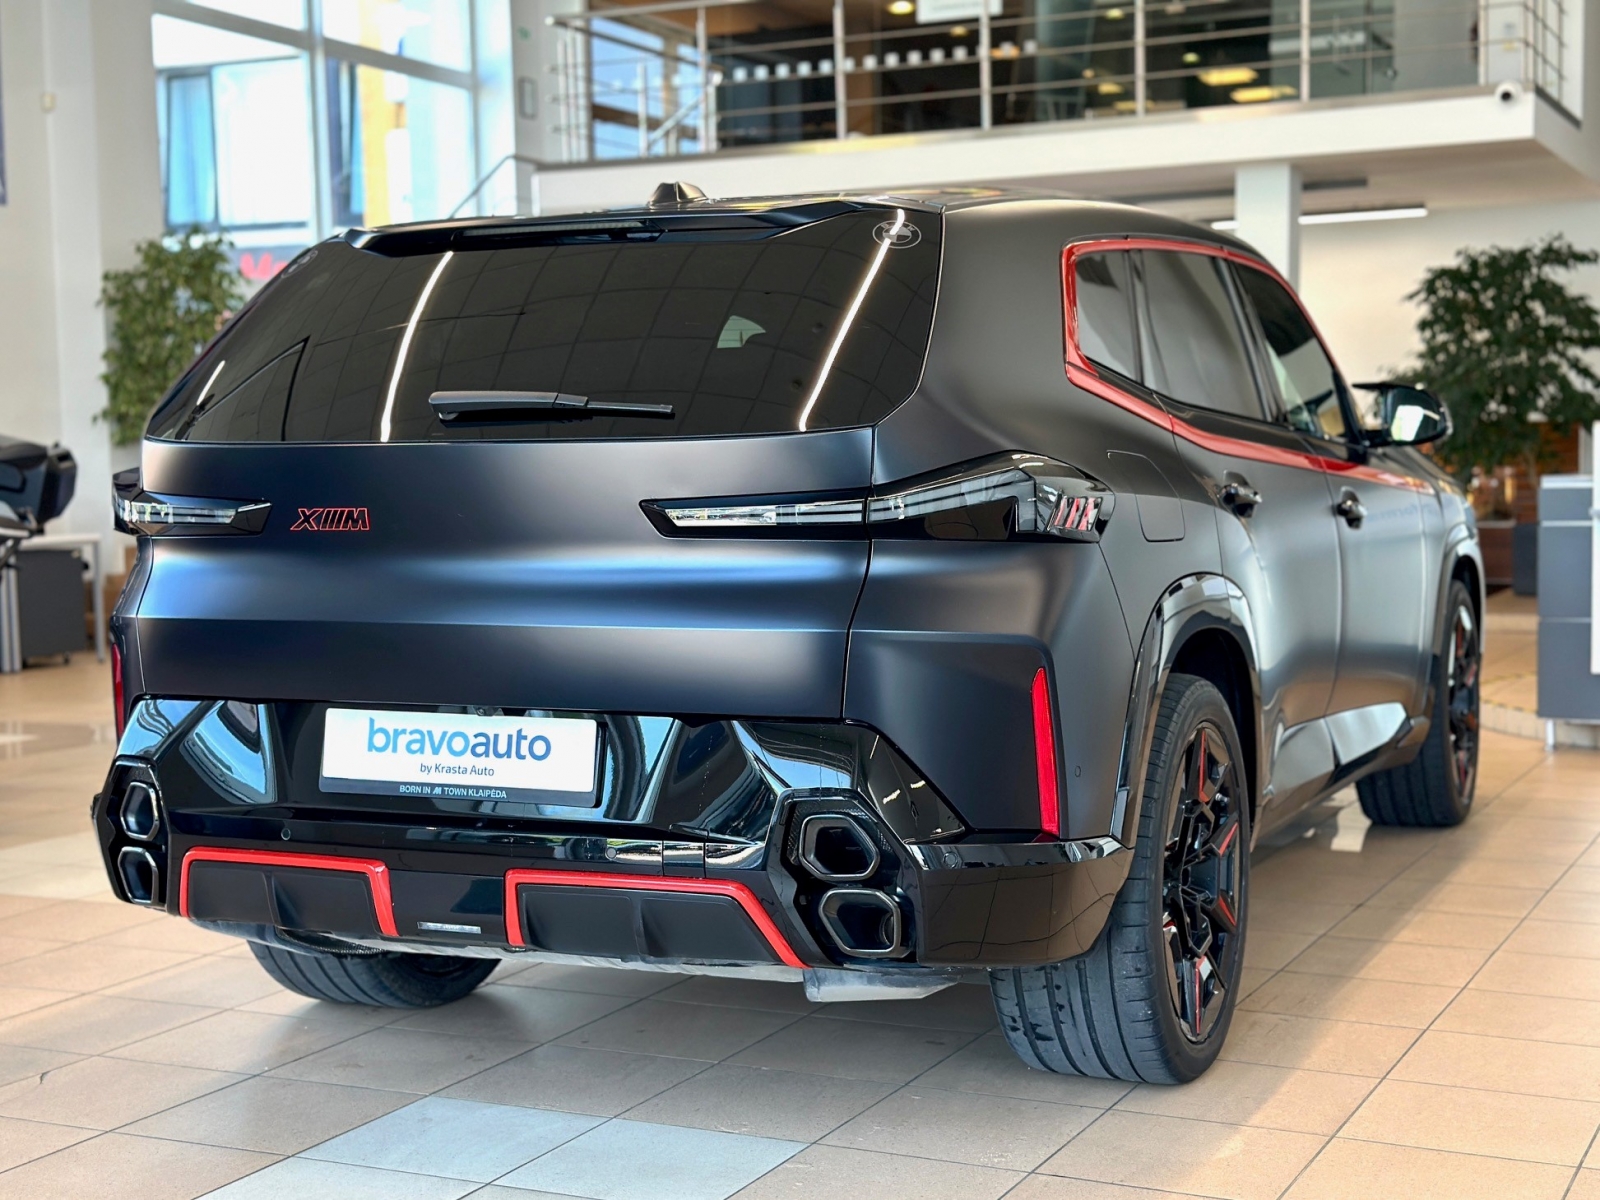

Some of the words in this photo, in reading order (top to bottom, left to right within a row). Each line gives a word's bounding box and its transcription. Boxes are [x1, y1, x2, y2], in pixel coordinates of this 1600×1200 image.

[367, 716, 552, 762] bravoauto
[419, 762, 433, 776] by
[434, 762, 468, 775] Krasta
[469, 764, 495, 777] Auto
[399, 784, 422, 794] BORN
[422, 785, 431, 795] IN
[443, 787, 467, 797] TOWN
